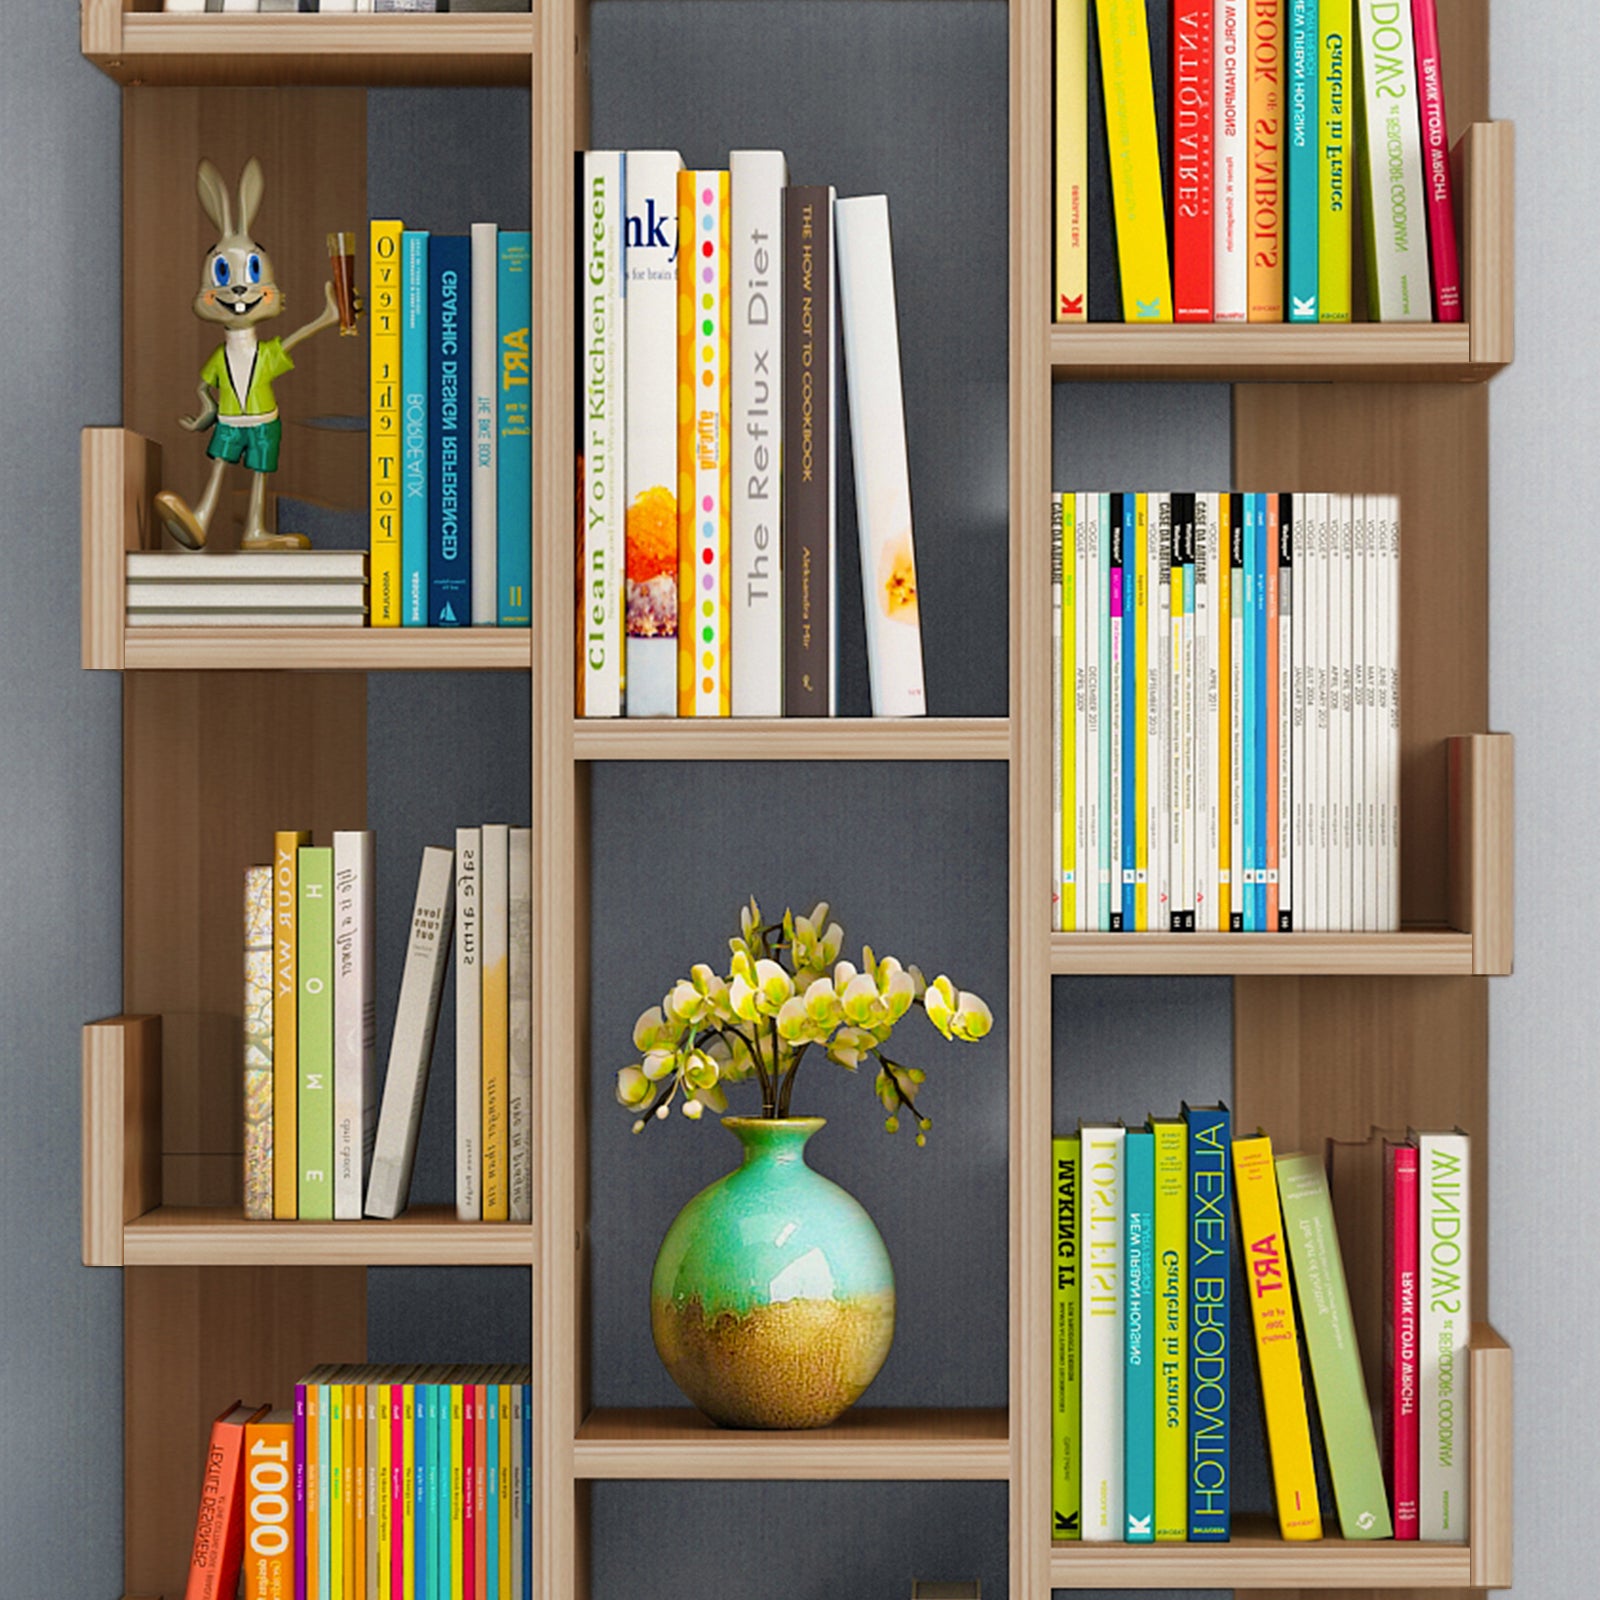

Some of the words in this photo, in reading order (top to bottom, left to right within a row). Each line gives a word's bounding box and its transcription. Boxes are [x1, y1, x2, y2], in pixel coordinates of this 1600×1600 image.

[588, 176, 604, 286] Green
[802, 204, 813, 239] THE
[747, 228, 769, 326] Diet
[802, 245, 813, 291] HOW
[802, 297, 813, 336] NOT
[1293, 296, 1315, 315] K
[588, 294, 604, 420] Kitchen
[802, 341, 813, 367] TO
[747, 350, 769, 500] Reflux
[802, 371, 813, 483] COOKBOOK
[588, 432, 604, 530] Your
[1077, 522, 1085, 552] VOGUE
[1089, 520, 1097, 551] VOGUE
[1149, 523, 1157, 553] VOGUE
[1209, 522, 1217, 553] VOGUE
[1295, 520, 1303, 550] VOGUE
[1307, 520, 1315, 550] VOGUE
[1319, 523, 1327, 553] VOGUE
[1331, 520, 1339, 549] VOGUE
[1343, 523, 1351, 553] VOGUE
[1355, 519, 1363, 549] VOGUE
[1367, 520, 1375, 550] VOGUE
[1379, 520, 1387, 550] VOGUE
[1391, 522, 1399, 552] VOGUE
[747, 524, 769, 608] The
[588, 550, 604, 670] Clean
[1055, 1510, 1078, 1530] K
[1128, 1514, 1151, 1534] K
